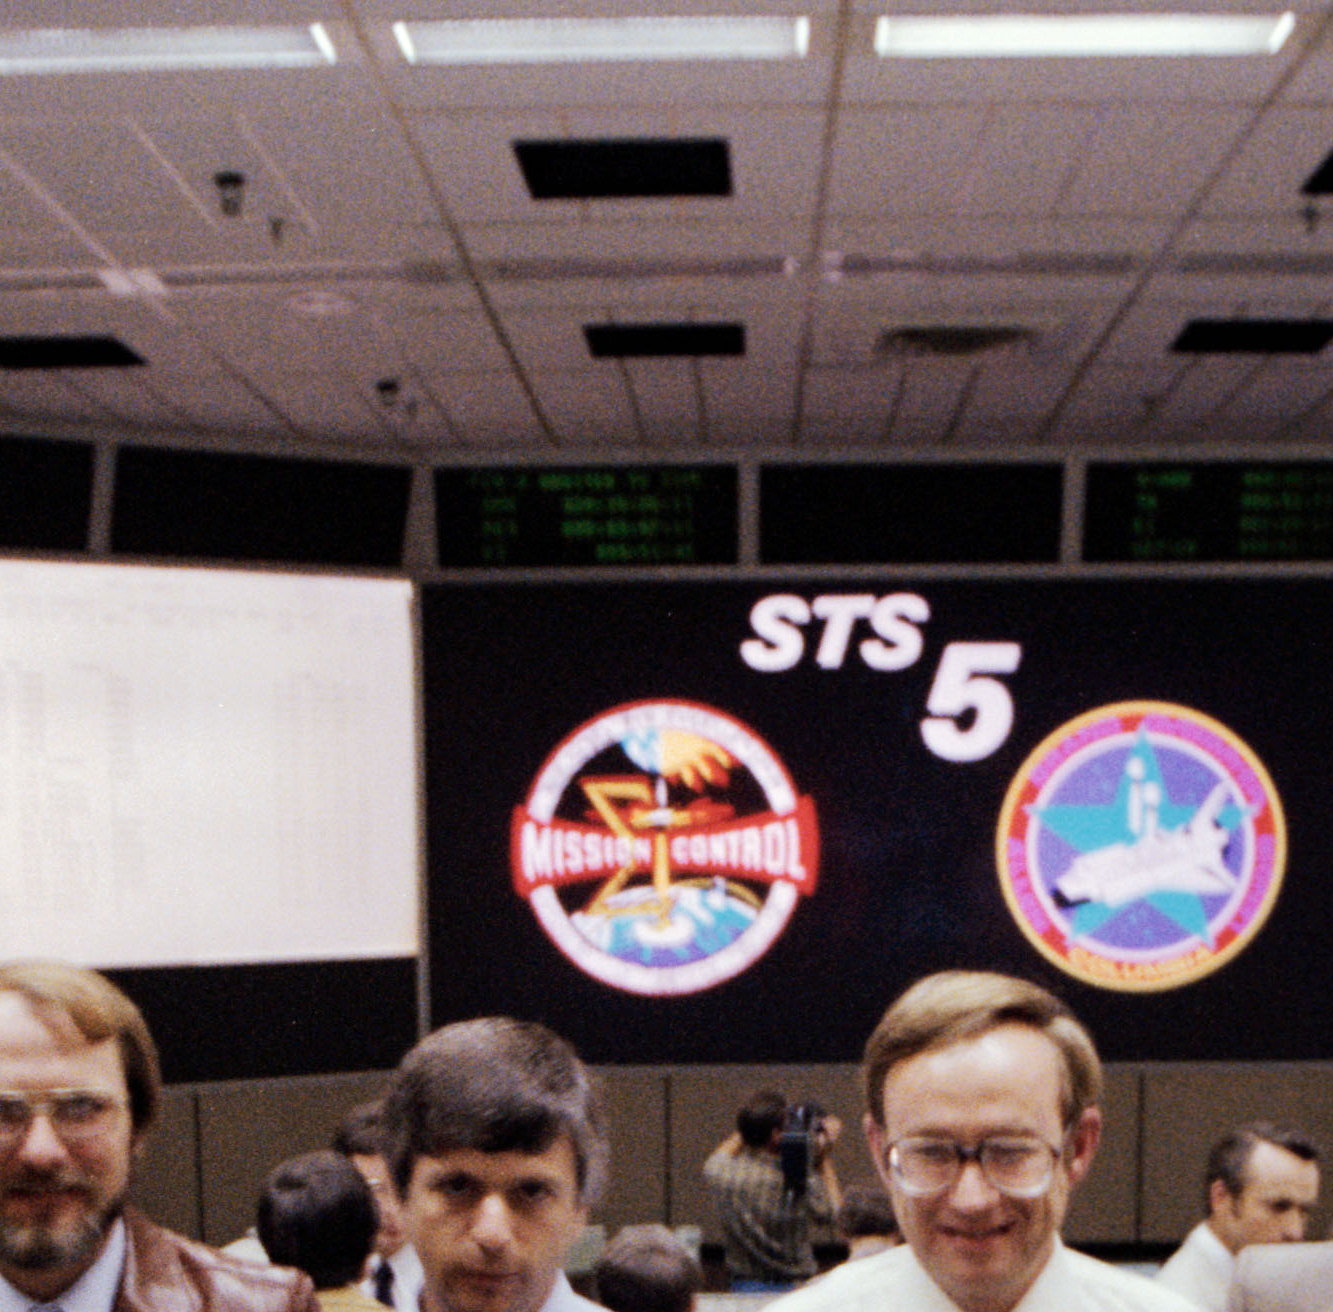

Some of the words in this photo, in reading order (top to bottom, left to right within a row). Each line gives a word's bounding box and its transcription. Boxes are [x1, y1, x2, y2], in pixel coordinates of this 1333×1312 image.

[739, 592, 931, 671] STS
[921, 641, 1021, 762] 5
[520, 820, 652, 883] MISSION
[671, 817, 807, 881] CONTROL
